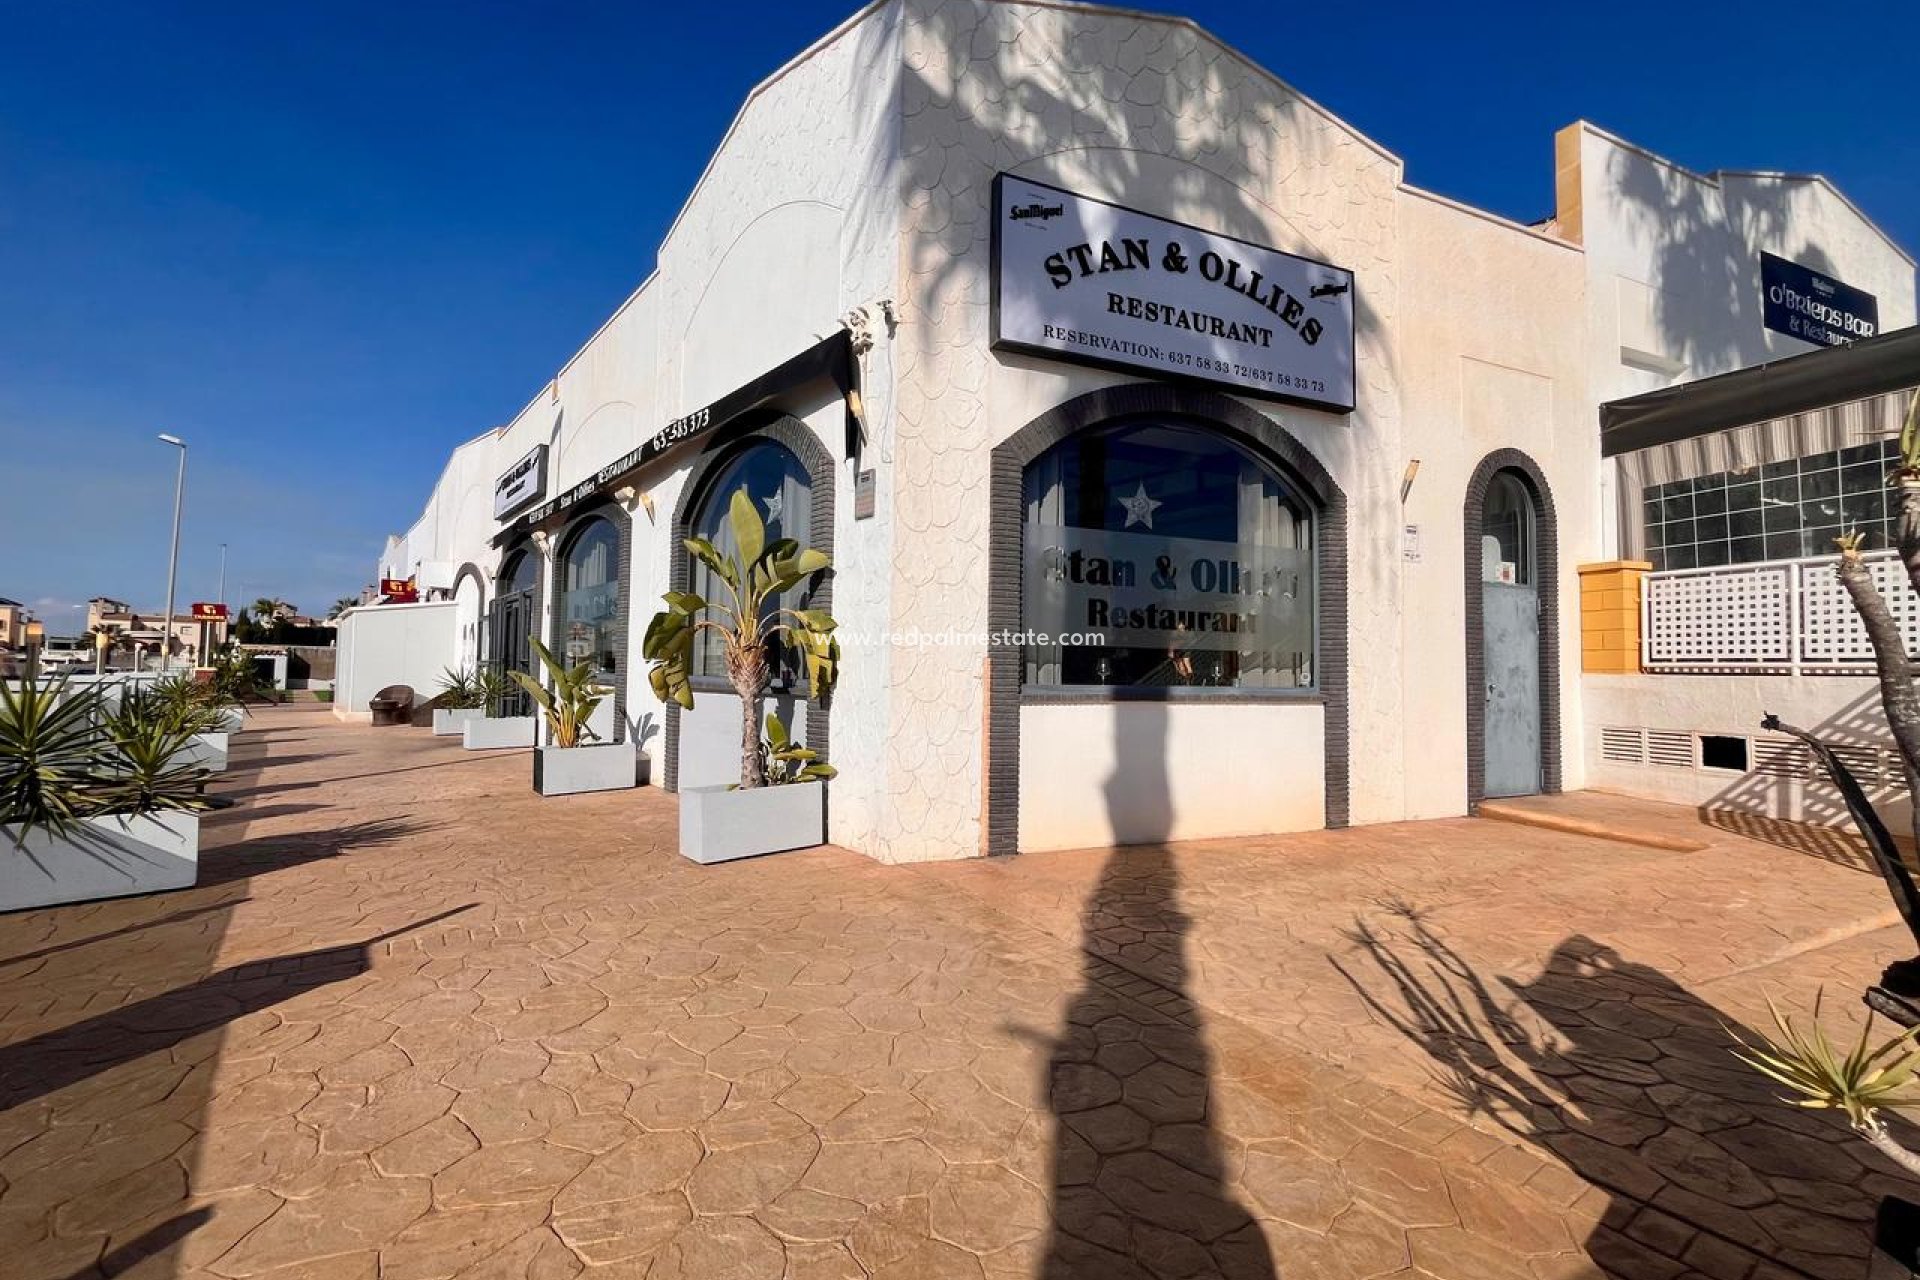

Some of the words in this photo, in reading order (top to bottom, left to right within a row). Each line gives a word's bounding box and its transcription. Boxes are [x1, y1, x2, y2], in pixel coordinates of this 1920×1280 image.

[1044, 239, 1150, 289] STAN
[1162, 241, 1189, 274] &
[1199, 251, 1324, 346] OLLIES
[1107, 292, 1273, 348] RESTAURANT
[1043, 324, 1164, 361] RESERVATION:
[1168, 352, 1192, 366] 637
[1196, 356, 1212, 370] 58
[1214, 360, 1230, 374] 33
[1277, 374, 1291, 387] 58
[1294, 377, 1308, 390] 33
[1311, 380, 1325, 393] 73
[690, 408, 709, 433] 373
[1151, 555, 1177, 590] &
